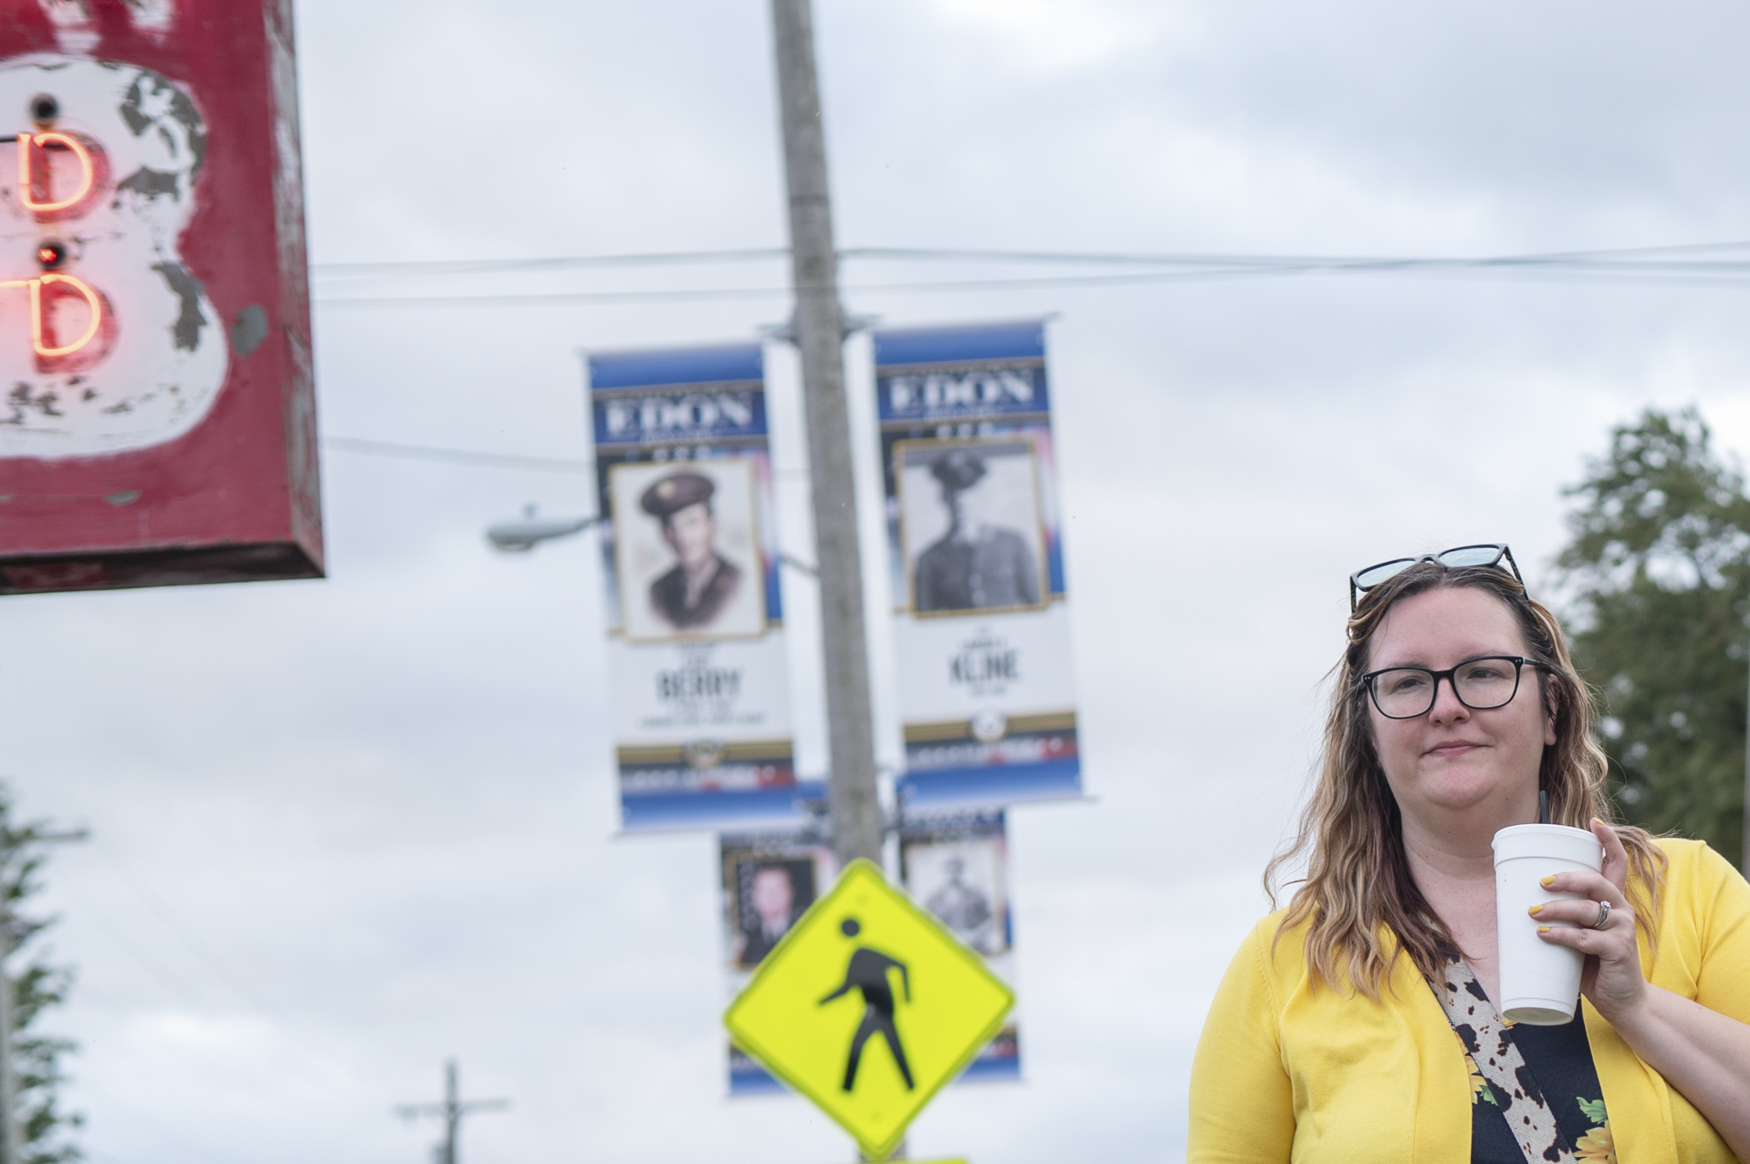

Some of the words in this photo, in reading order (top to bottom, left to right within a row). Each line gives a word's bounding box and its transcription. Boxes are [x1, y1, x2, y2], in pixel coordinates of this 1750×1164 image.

[890, 370, 1034, 413] EDON
[606, 393, 752, 437] EDON
[657, 669, 743, 699] BERRY
